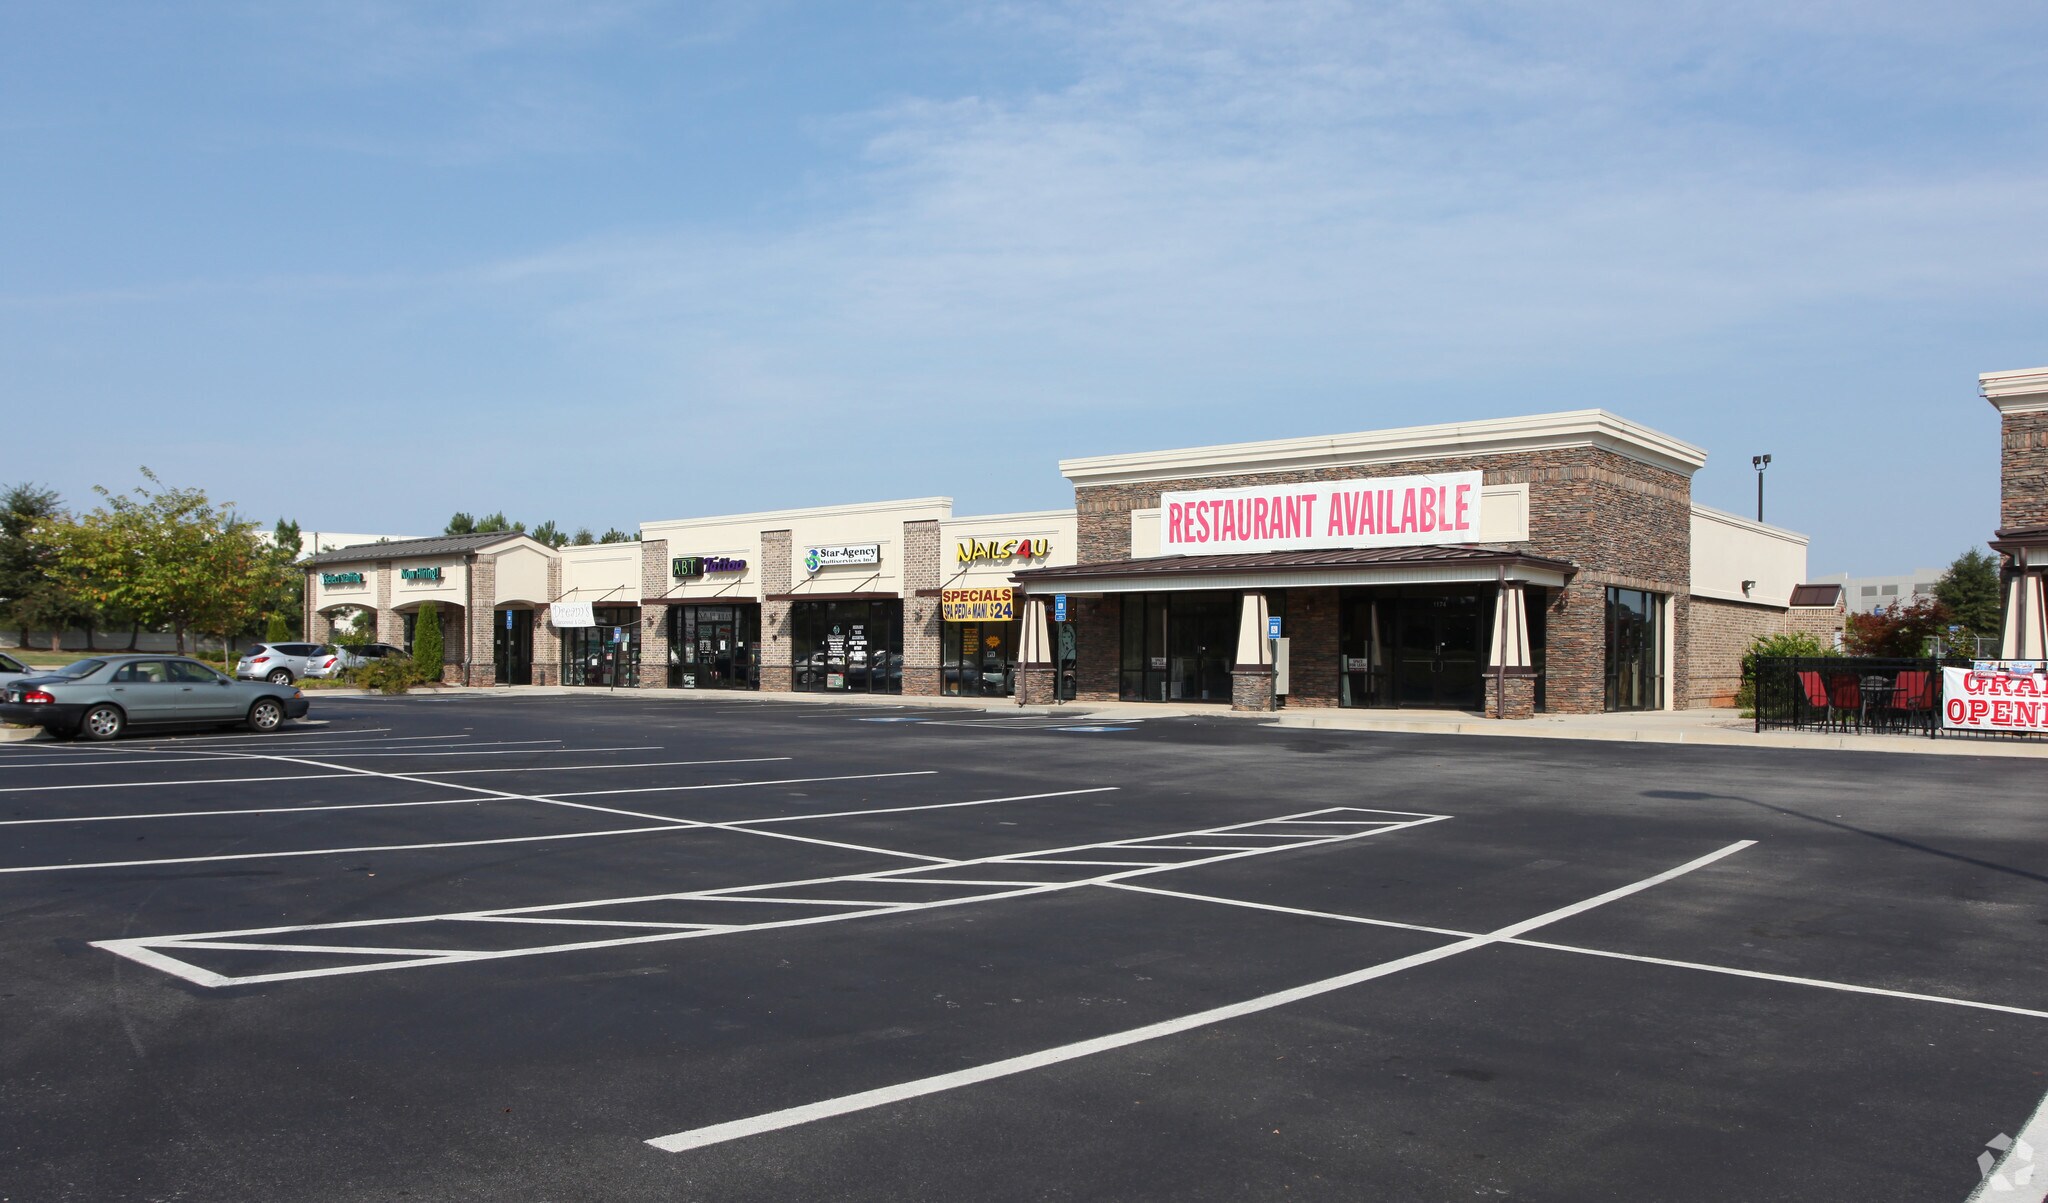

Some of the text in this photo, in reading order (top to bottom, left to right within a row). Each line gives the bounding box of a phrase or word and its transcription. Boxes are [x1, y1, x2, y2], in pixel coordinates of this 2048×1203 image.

[1169, 484, 1471, 543] RESTAURANT AVAILABLE
[674, 560, 696, 575] ABT
[703, 556, 747, 574] Tattoo
[401, 567, 440, 580] Now Hiring!
[943, 589, 1011, 602] SPECIALS
[944, 603, 953, 619] SPA
[990, 602, 1012, 618] $24
